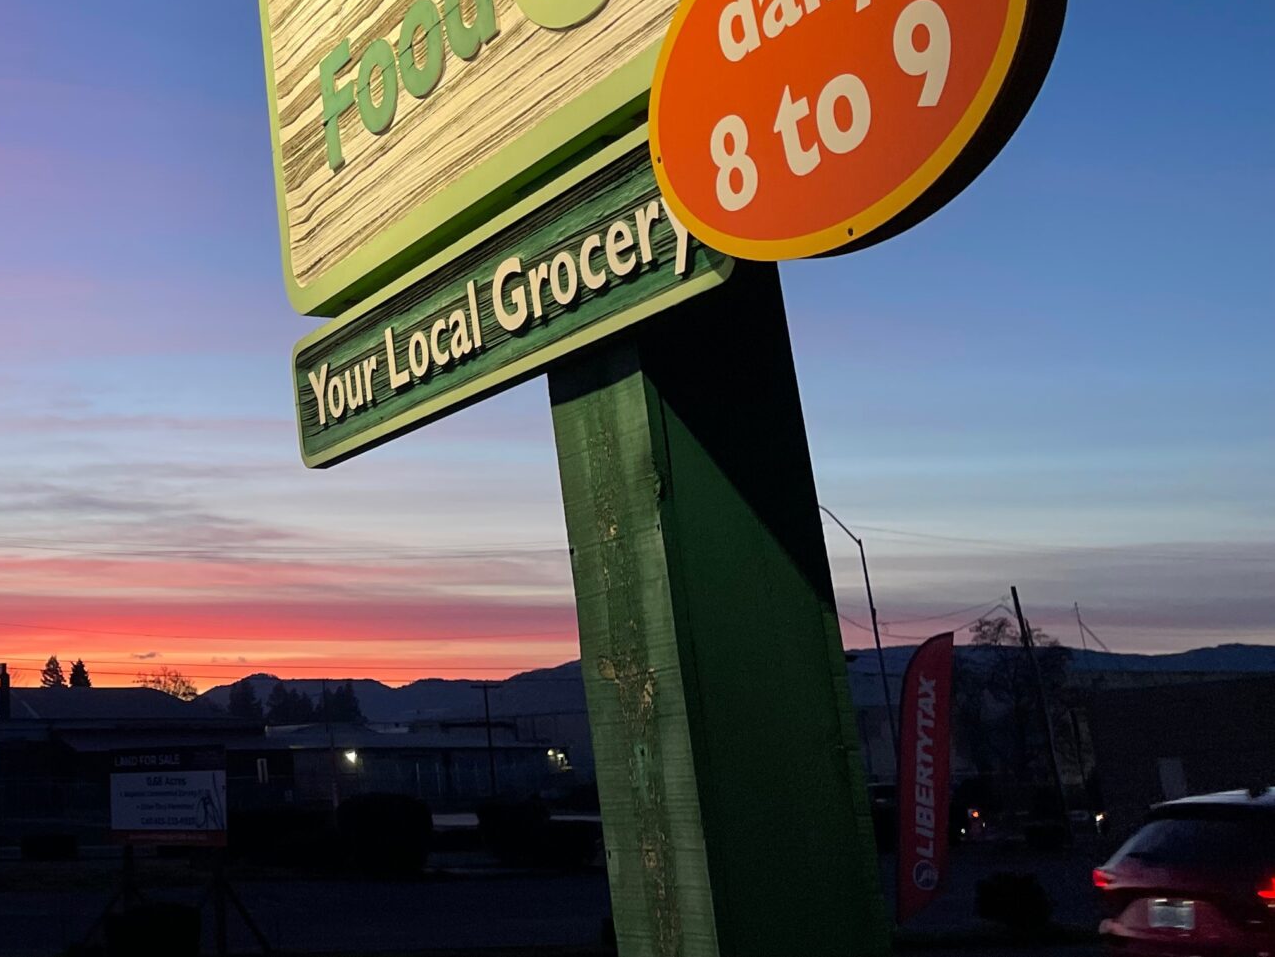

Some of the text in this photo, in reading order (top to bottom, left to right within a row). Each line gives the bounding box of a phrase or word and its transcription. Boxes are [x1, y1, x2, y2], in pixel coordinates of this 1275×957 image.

[710, 114, 759, 212] 8
[773, 73, 872, 176] to
[308, 353, 378, 425] Your
[384, 280, 482, 391] Local
[114, 755, 137, 766] LAND
[139, 755, 157, 765] FOR
[159, 753, 181, 765] SALE
